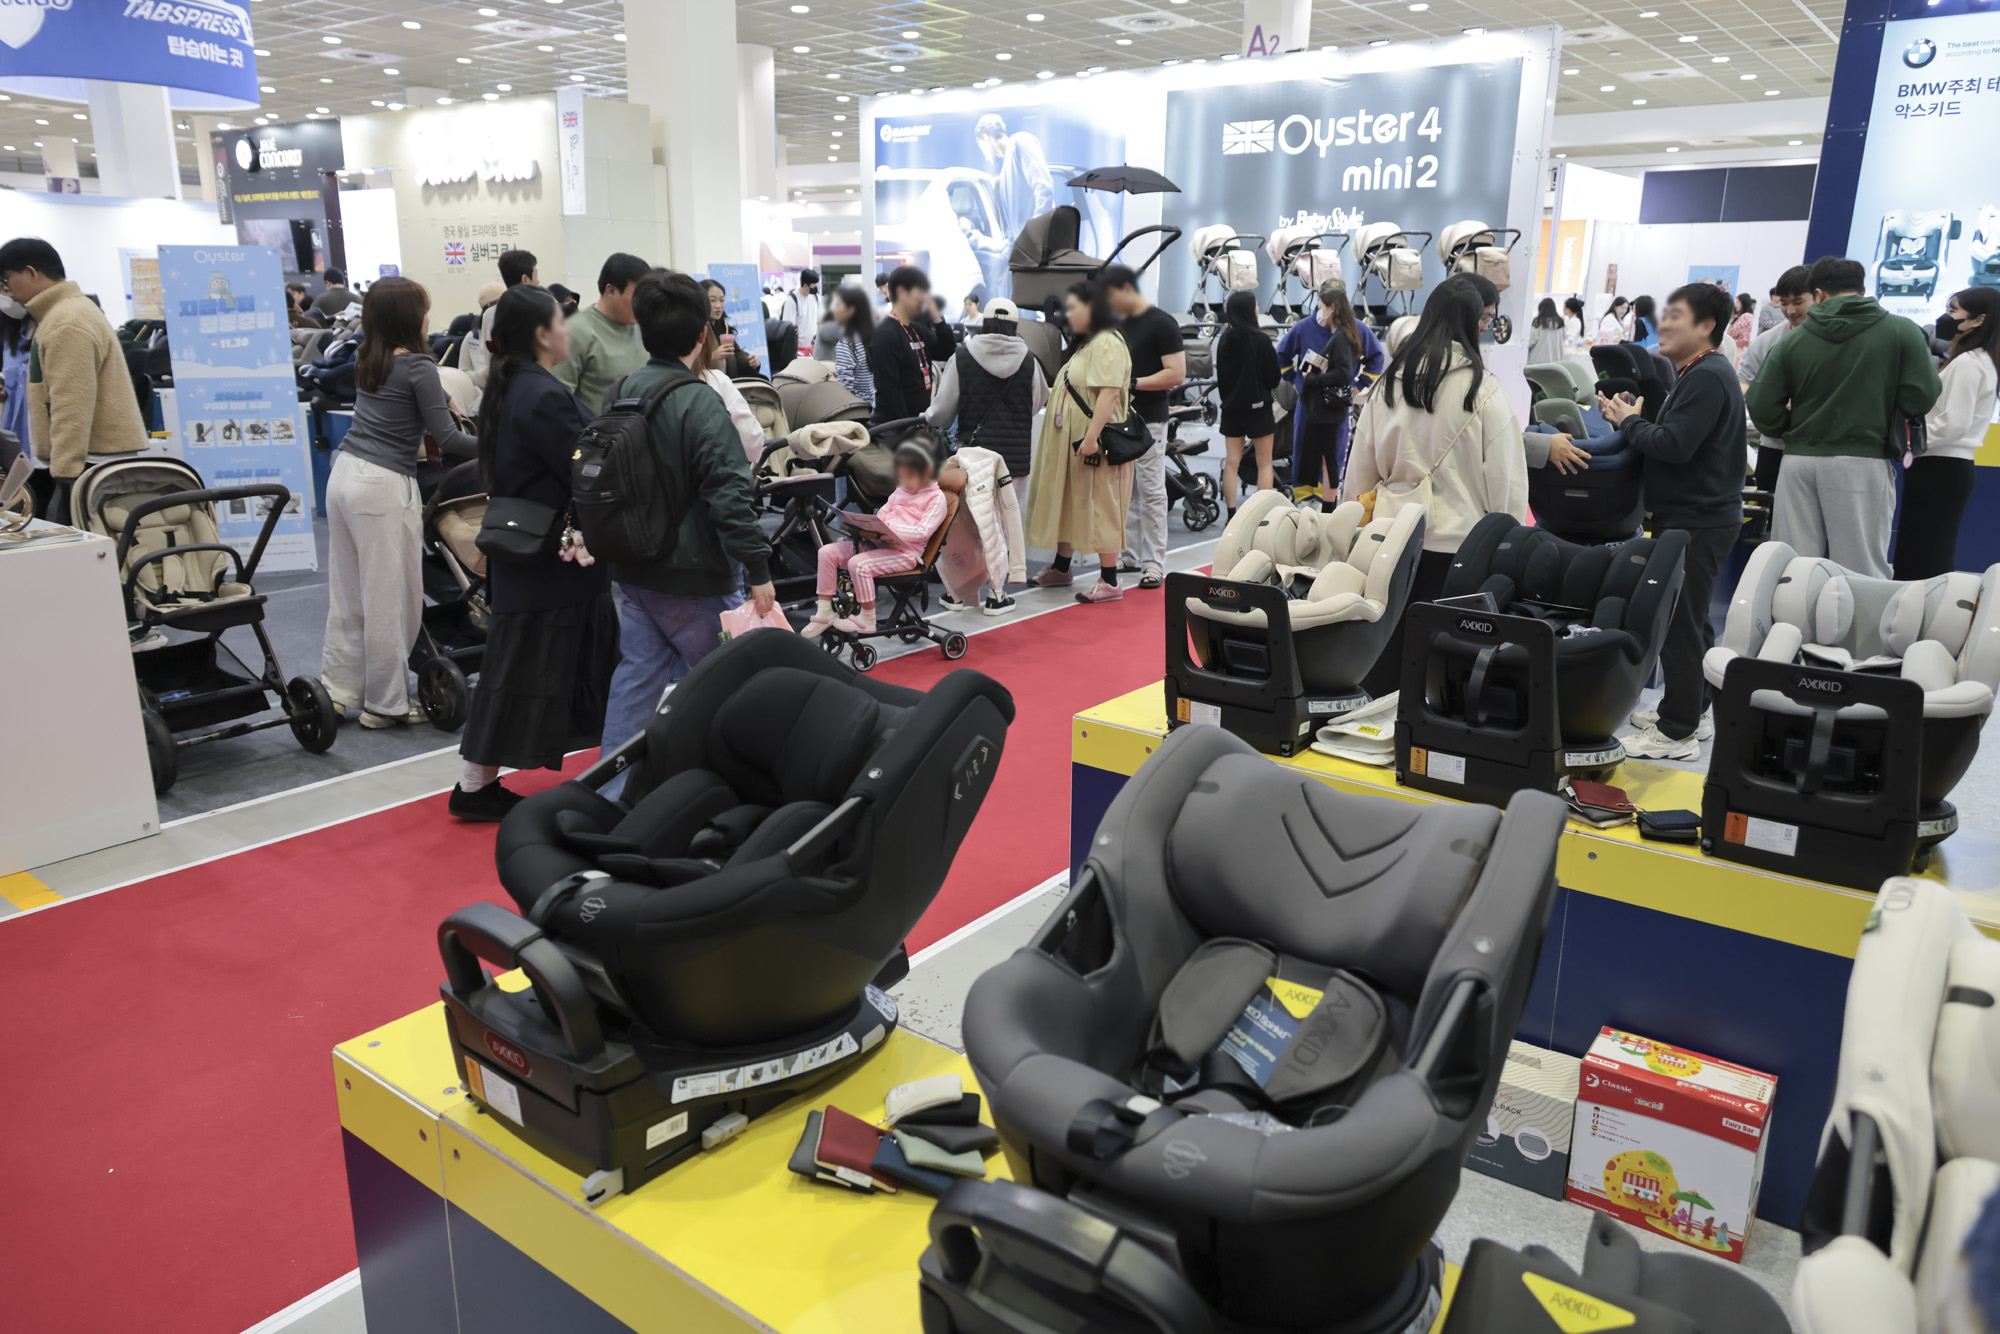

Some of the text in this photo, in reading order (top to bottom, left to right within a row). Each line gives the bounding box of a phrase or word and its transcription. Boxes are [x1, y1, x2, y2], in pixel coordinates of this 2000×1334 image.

[122, 0, 241, 38] TABSPRESS
[1246, 24, 1280, 58] A2
[167, 35, 229, 65] 탑승하는
[1944, 48, 1982, 58] according
[1897, 77, 1982, 98] BMW주최
[1894, 101, 1961, 119] 악스키드
[1278, 106, 1442, 158] Oyster 4
[1342, 154, 1439, 191] mini 2
[1279, 214, 1294, 228] by
[443, 223, 519, 239] 영국 왕실 프리미엄 브랜드
[193, 250, 247, 265] Oyster
[1602, 1079, 1632, 1093] Classic
[1500, 1104, 1522, 1116] PACK
[1725, 1119, 1755, 1134] Fairy Bar
